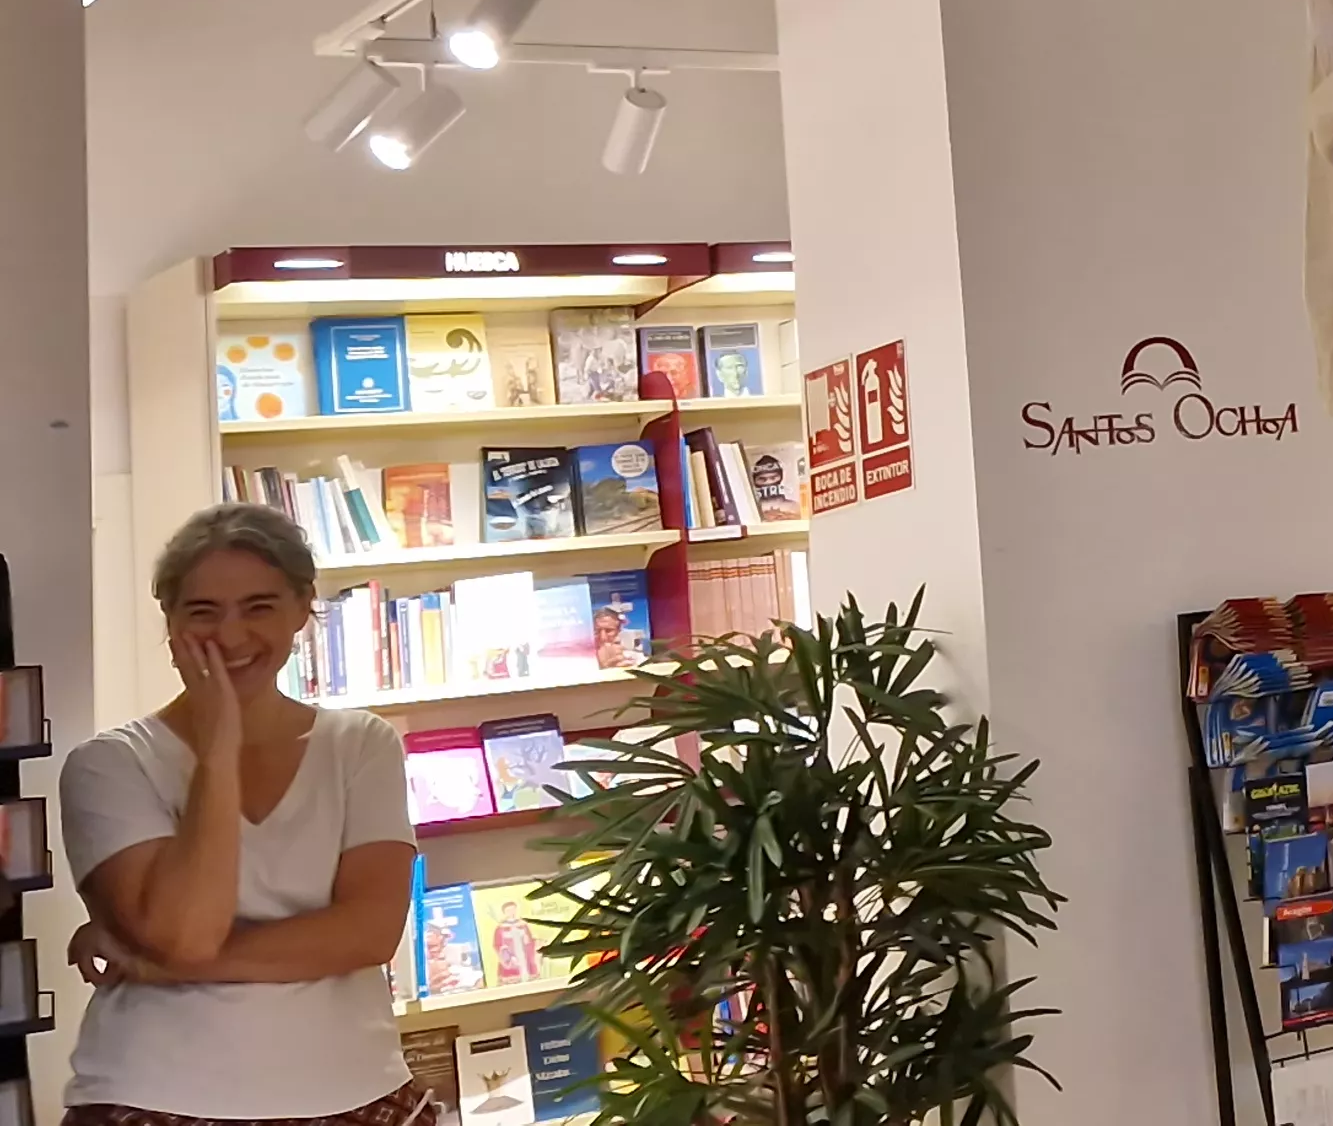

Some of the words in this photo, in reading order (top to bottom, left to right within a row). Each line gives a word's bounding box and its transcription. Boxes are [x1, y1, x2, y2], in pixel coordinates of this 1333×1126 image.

[445, 251, 520, 272] HUESCA
[815, 470, 840, 492] BOCA
[839, 467, 852, 486] DE
[866, 460, 909, 485] EXTINTOR
[814, 487, 856, 511] INCENDIO
